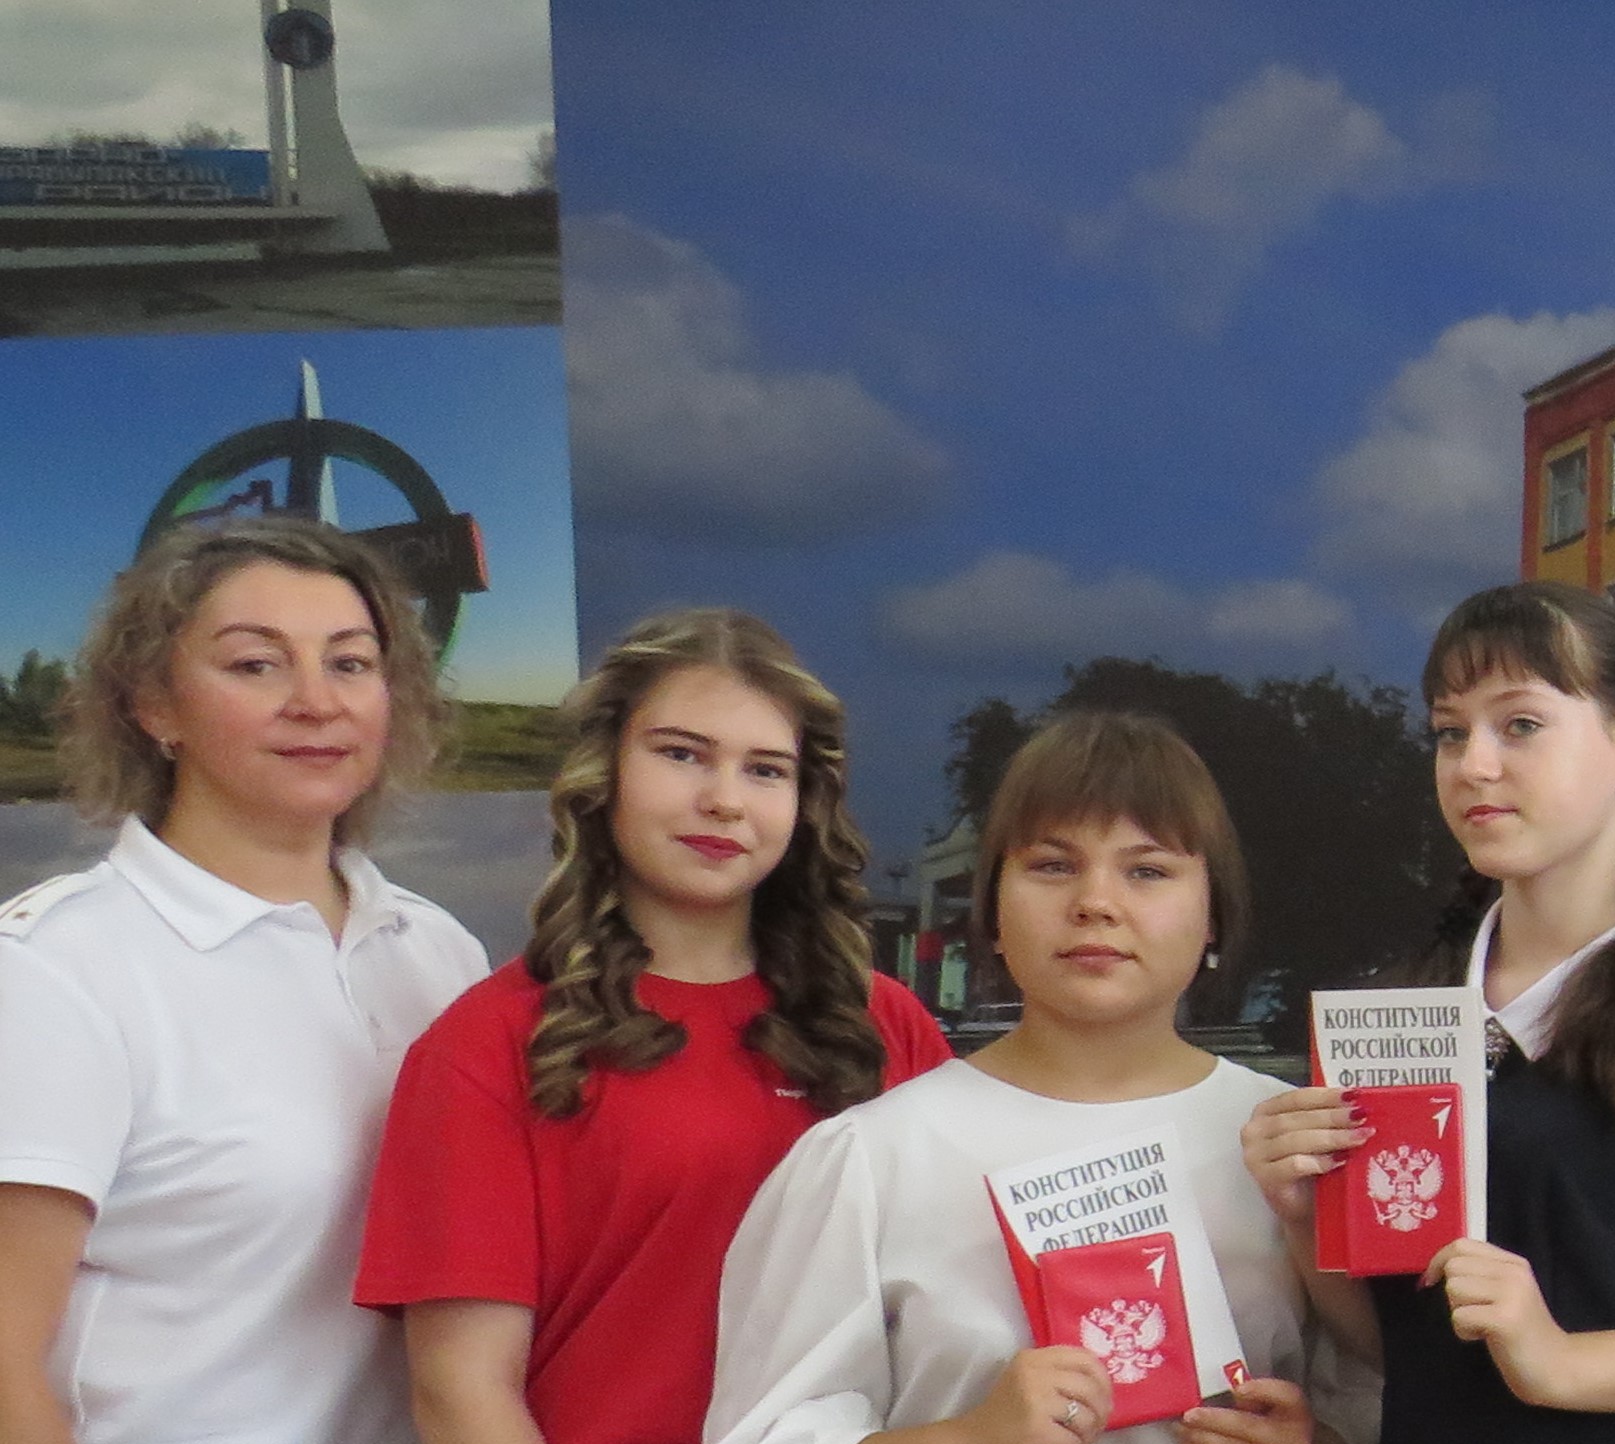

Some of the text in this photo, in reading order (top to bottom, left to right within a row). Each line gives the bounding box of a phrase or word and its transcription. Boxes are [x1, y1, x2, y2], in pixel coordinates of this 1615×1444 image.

[1324, 1006, 1461, 1030] КОНСТИТУЦИЯ
[1331, 1033, 1457, 1059] РОССИЙСКОЙ
[1339, 1067, 1452, 1087] ФЕДЕРАЦИИ
[1009, 1143, 1166, 1205] КОНСТИТУЦИЯ
[1025, 1169, 1168, 1232] РОССИЙСКОЙ
